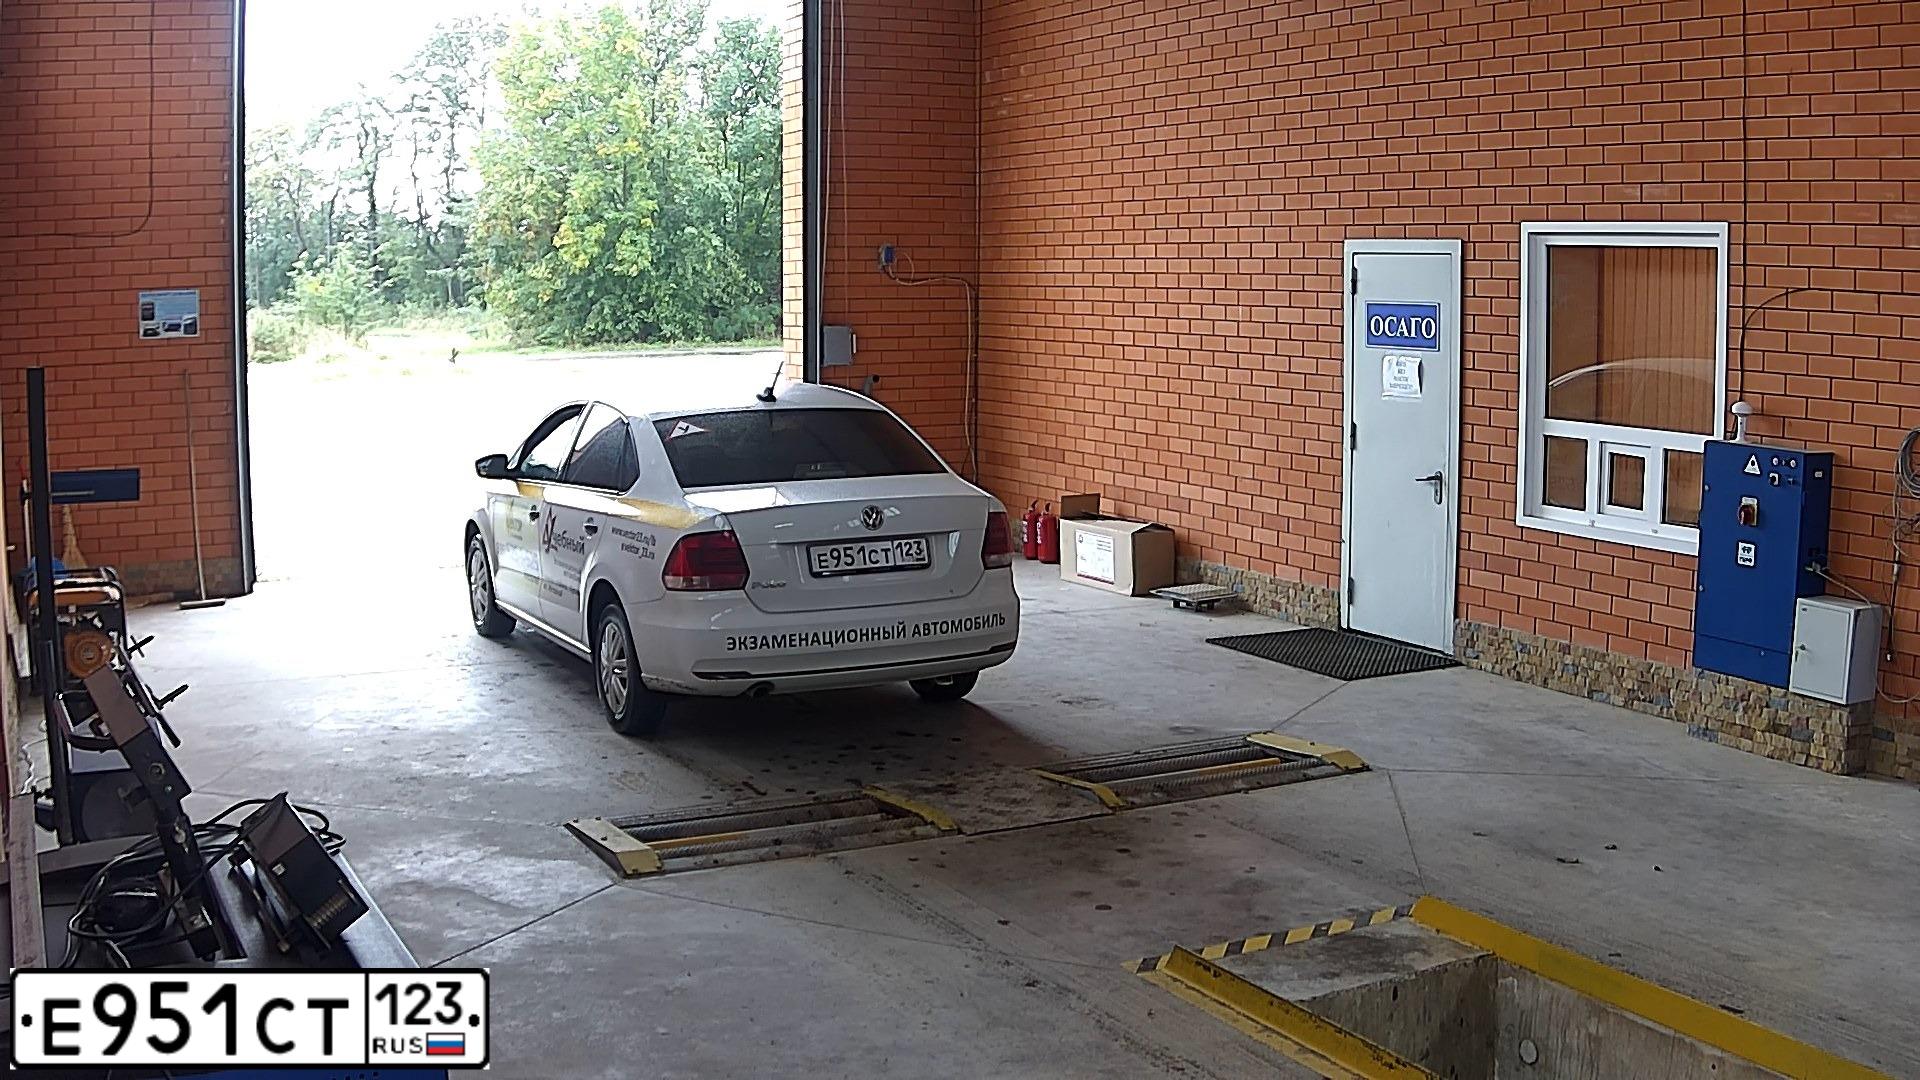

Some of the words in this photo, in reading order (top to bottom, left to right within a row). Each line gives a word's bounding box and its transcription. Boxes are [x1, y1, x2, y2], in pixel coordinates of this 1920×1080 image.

[1370, 315, 1436, 339] ОСАГО
[895, 540, 925, 558] 123
[726, 622, 907, 651] ЭКЗАМЕНАЦИОННЫЙ
[912, 612, 1006, 638] АВТОМОБИЛЬ
